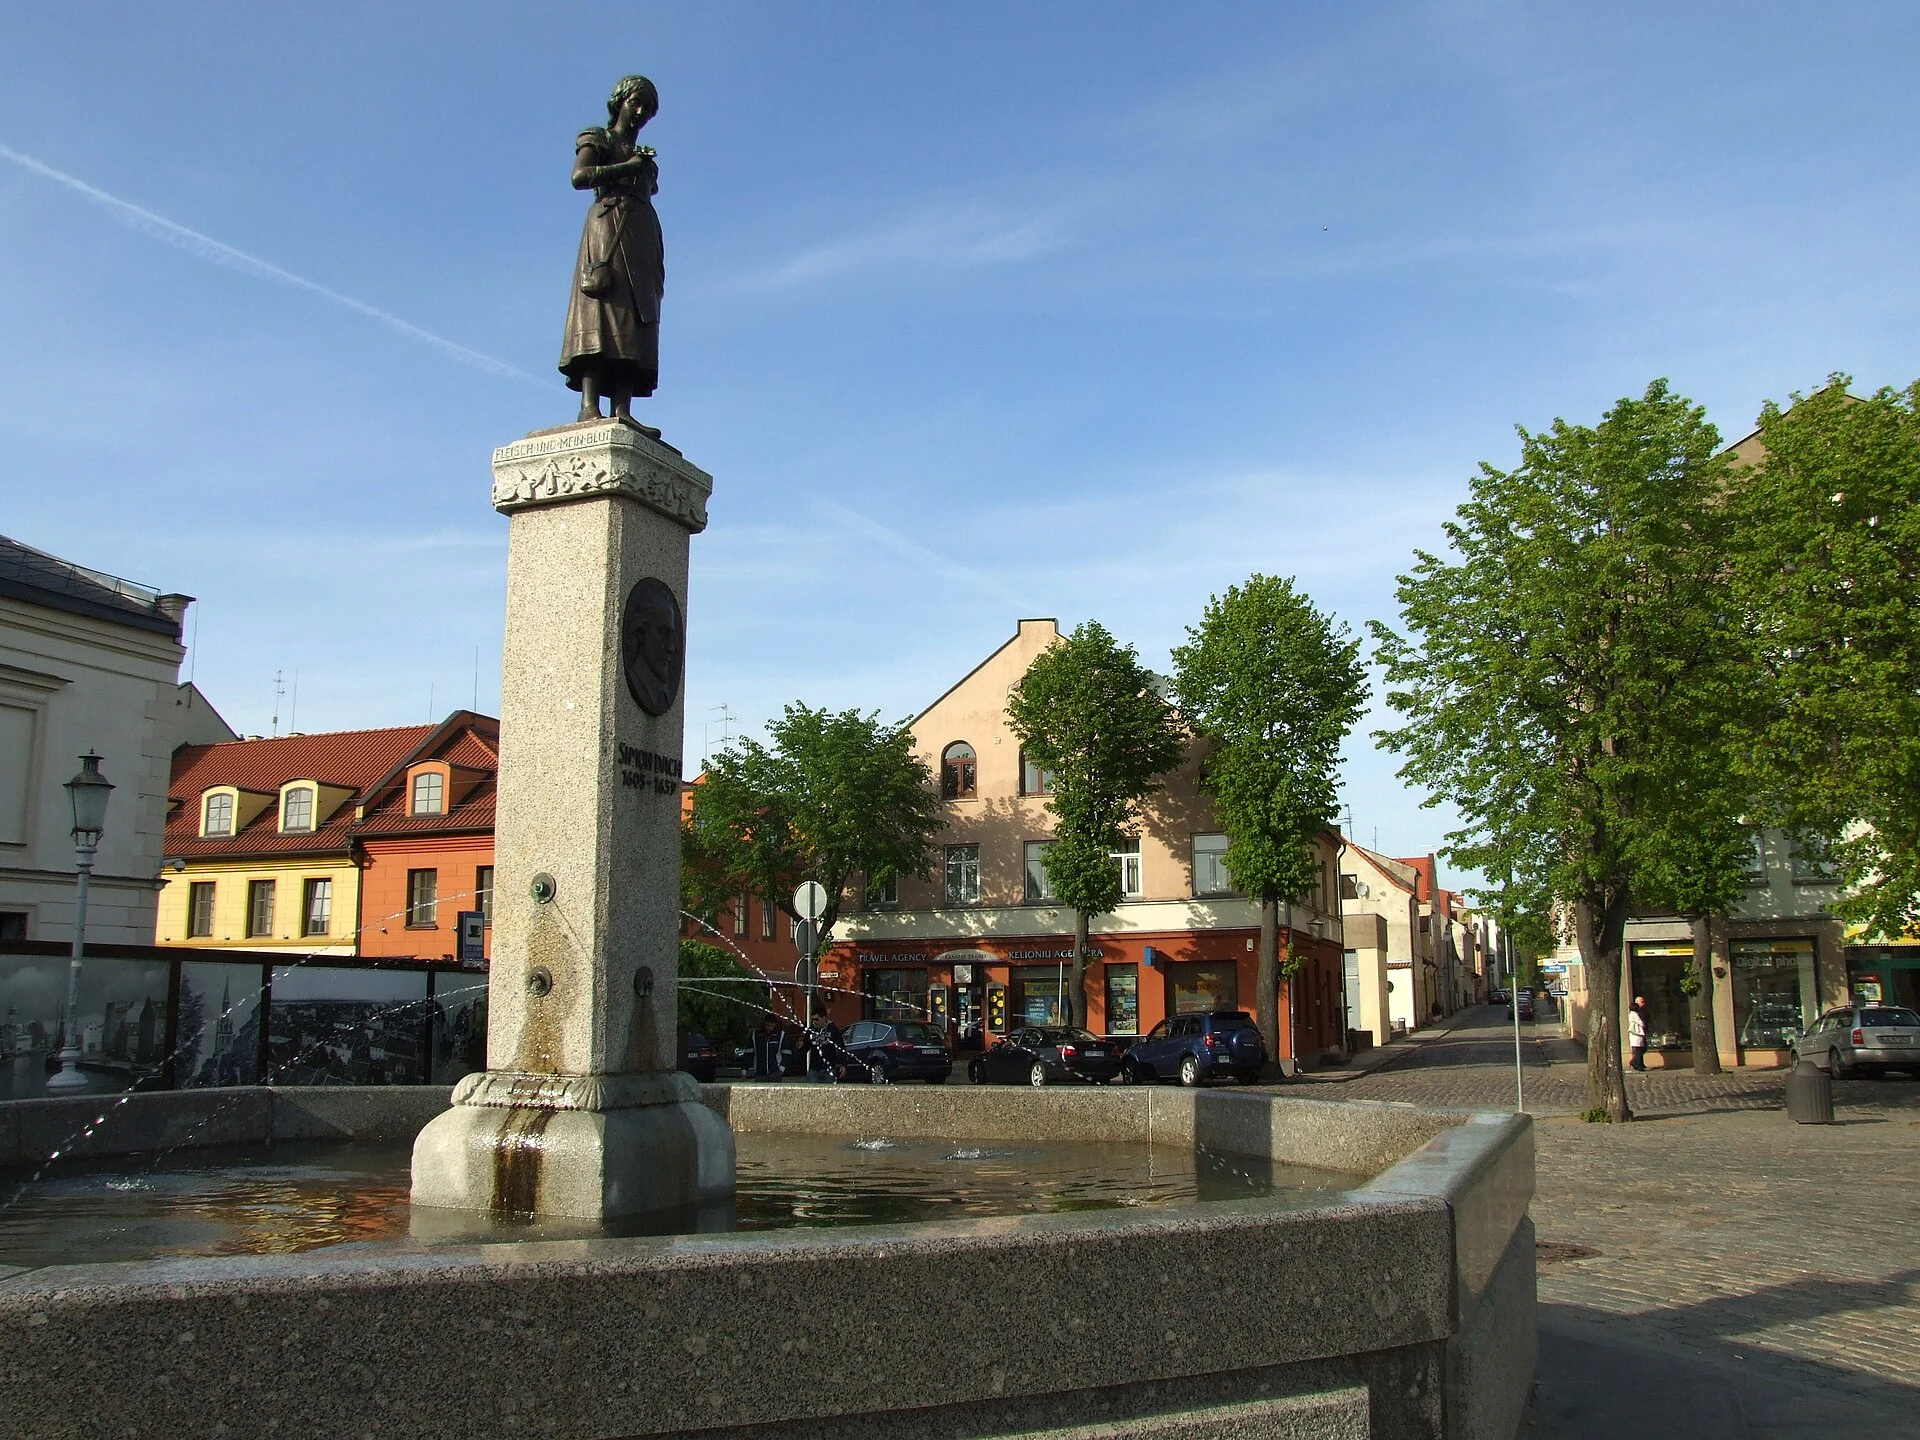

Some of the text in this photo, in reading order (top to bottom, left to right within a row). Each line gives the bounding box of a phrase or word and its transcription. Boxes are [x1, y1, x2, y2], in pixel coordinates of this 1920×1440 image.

[495, 430, 611, 460] FLEISCH UND MEIN BLUT
[858, 953, 927, 962] TRAVEL AGENCY
[1054, 948, 1104, 958] AGERA
[1735, 955, 1773, 969] Digital
